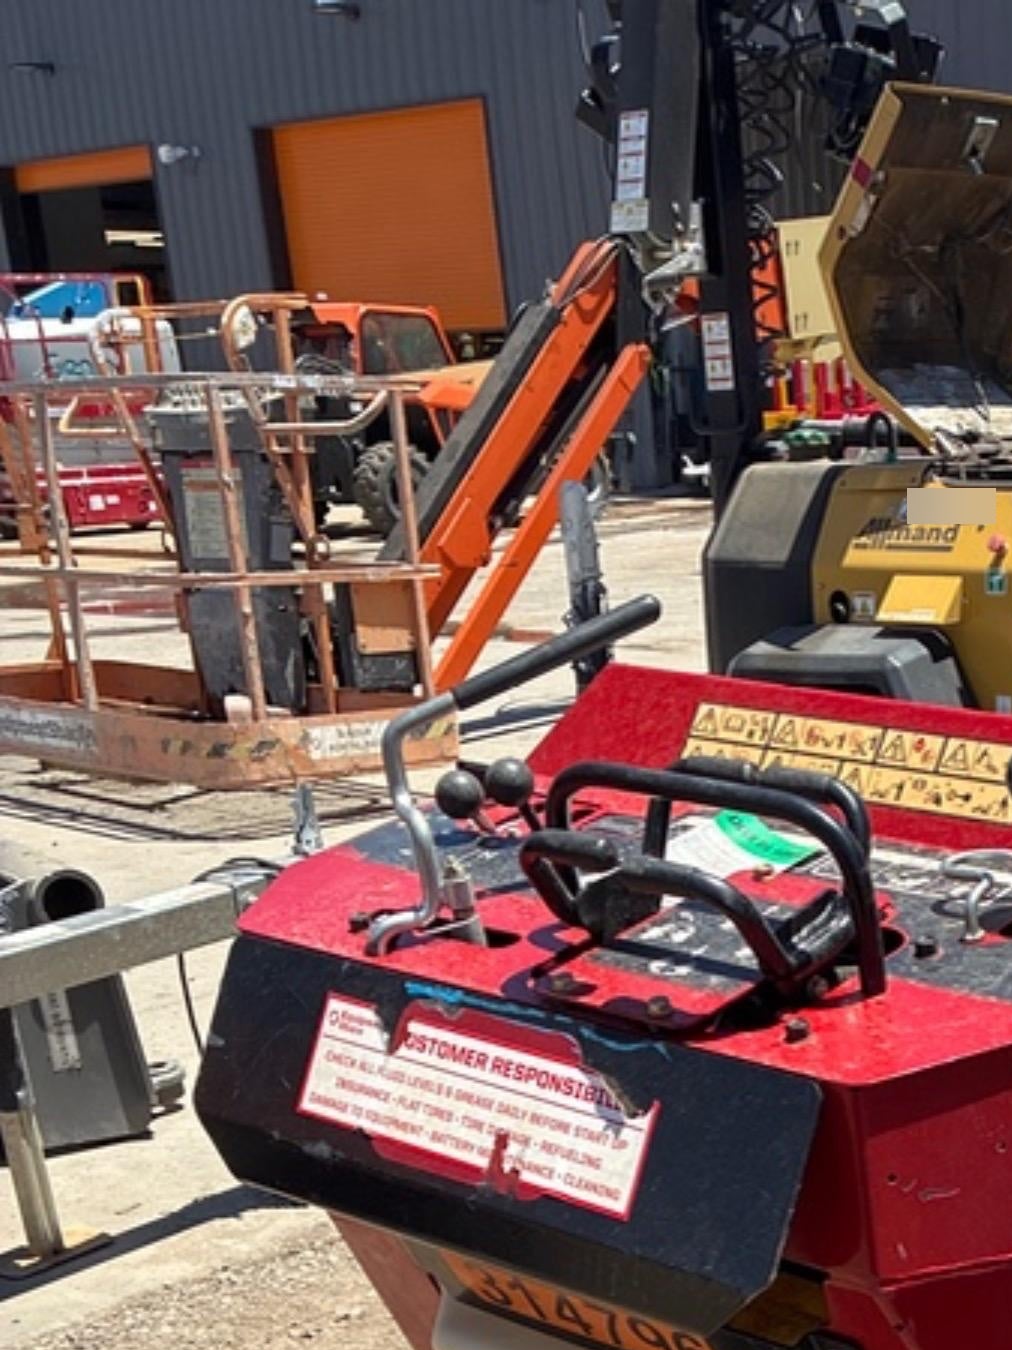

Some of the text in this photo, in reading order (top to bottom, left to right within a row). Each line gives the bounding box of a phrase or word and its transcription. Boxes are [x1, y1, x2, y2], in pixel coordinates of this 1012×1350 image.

[404, 1032, 488, 1070] USTOMER
[530, 1111, 571, 1135] BEFORE
[563, 1173, 622, 1201] CLEANING
